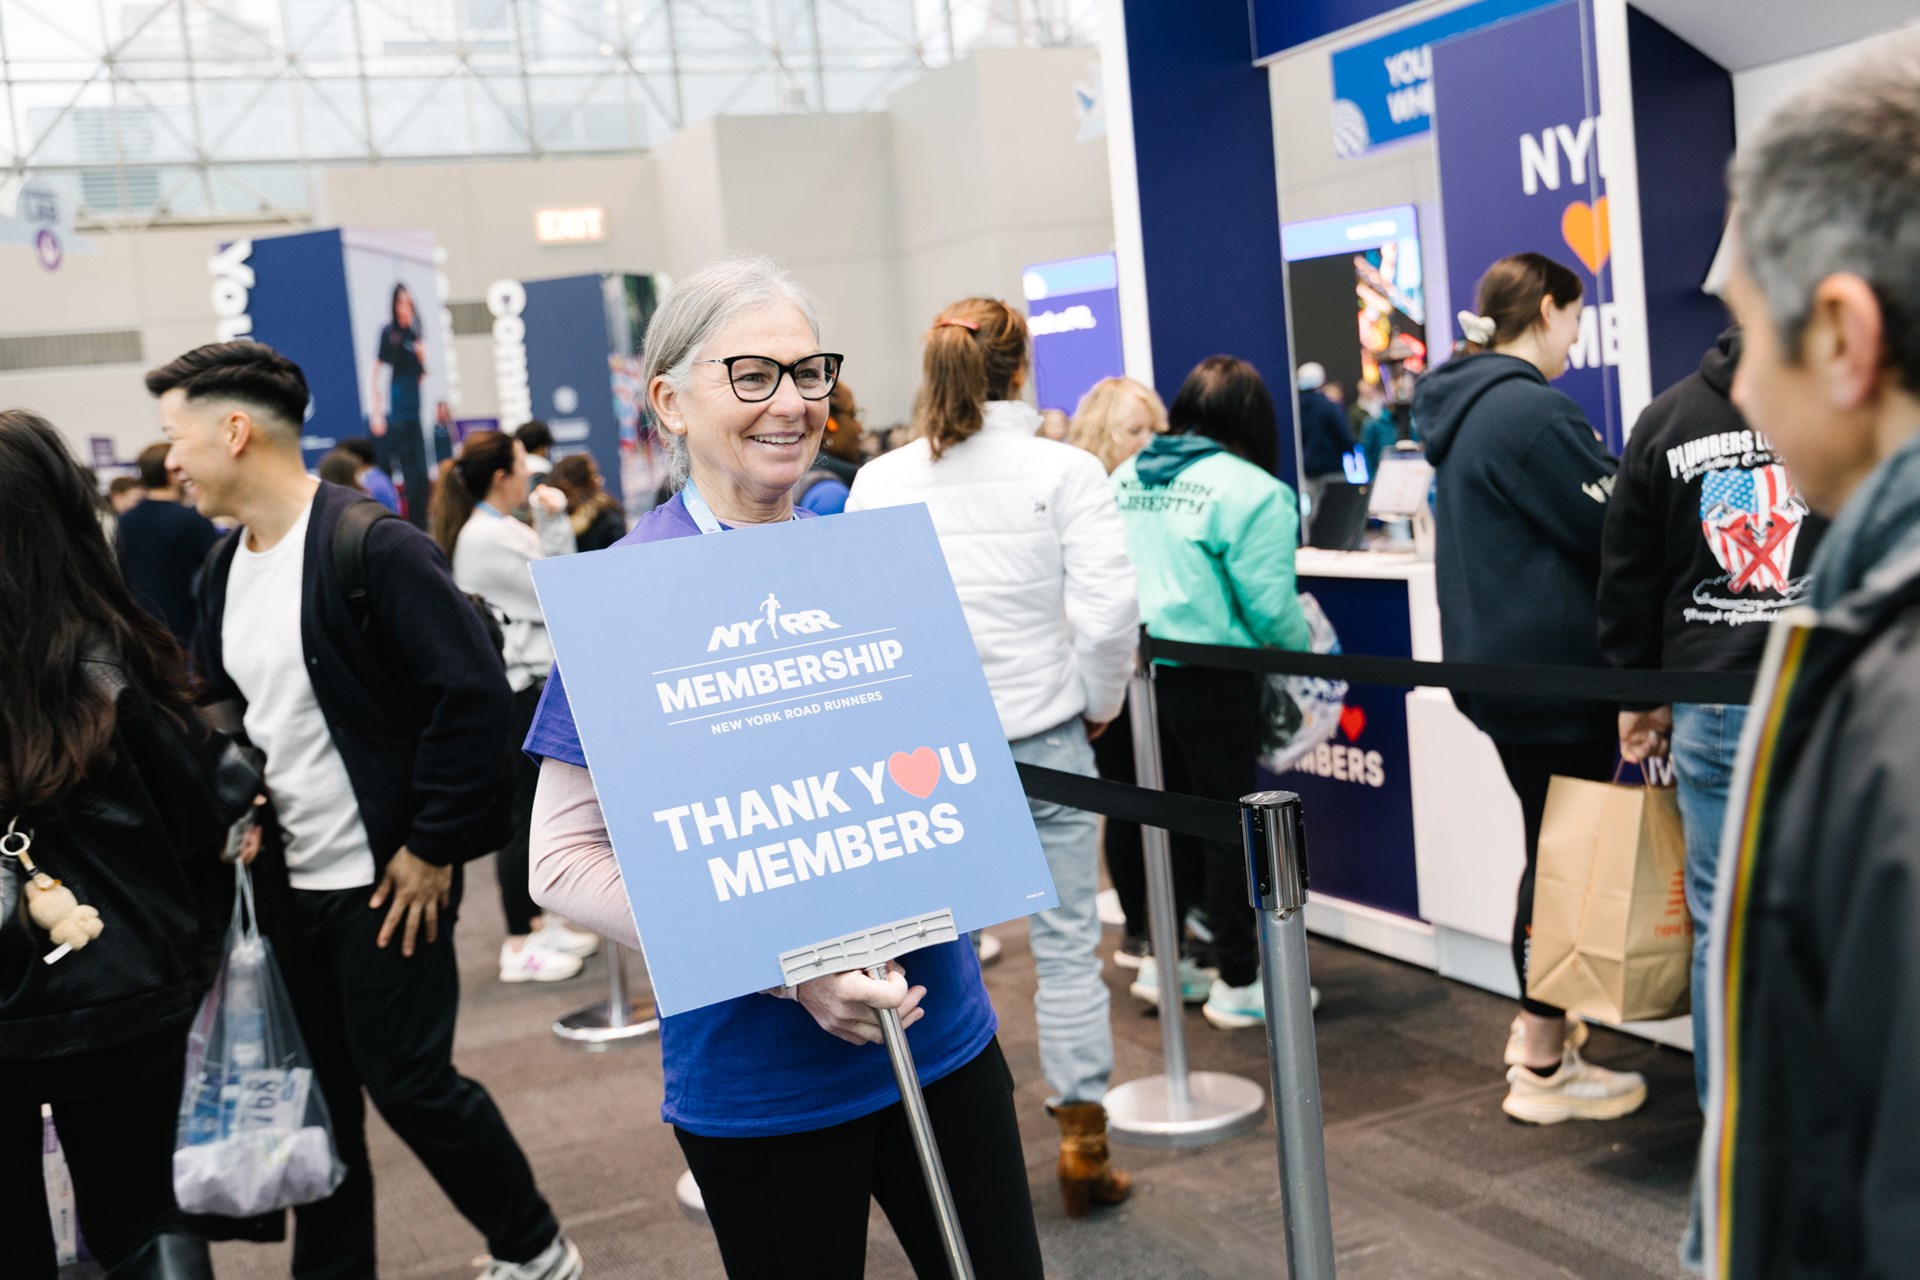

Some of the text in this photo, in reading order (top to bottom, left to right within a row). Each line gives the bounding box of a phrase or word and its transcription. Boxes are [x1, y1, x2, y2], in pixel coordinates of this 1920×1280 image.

[1520, 115, 1607, 195] NY
[1666, 429, 1754, 479] PLUMBERS
[656, 639, 903, 713] MEMBERSHIP
[711, 691, 883, 735] NEW YORK ROAD RUNNERS
[652, 770, 852, 852] THANK
[707, 802, 965, 902] MEMBERS
